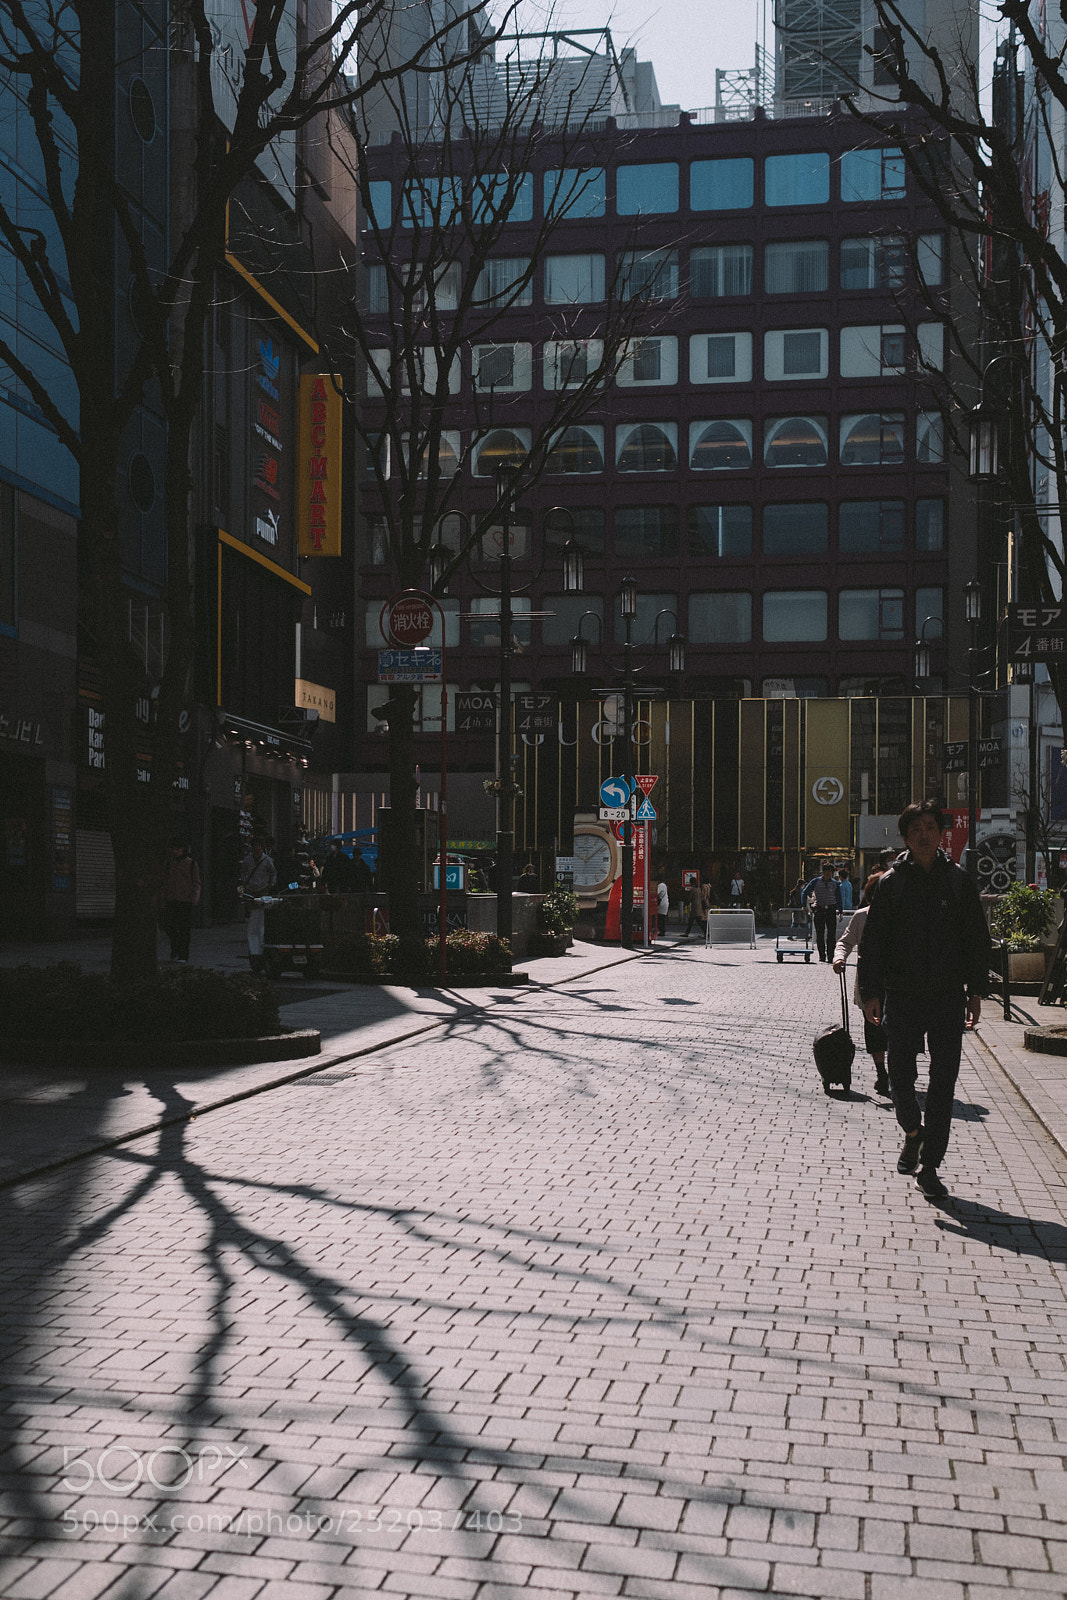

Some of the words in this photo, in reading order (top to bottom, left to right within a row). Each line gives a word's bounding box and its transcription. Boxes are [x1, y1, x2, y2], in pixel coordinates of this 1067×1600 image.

[256, 516, 276, 546] PUMA
[393, 611, 430, 632] 消火栓
[1016, 608, 1062, 627] モア
[1014, 635, 1065, 657] 4番街
[395, 651, 442, 667] セキネ
[302, 692, 334, 710] TAKANO
[458, 697, 493, 710] MOA
[520, 696, 551, 709] モア
[946, 744, 964, 755] モア
[979, 742, 999, 753] MOA
